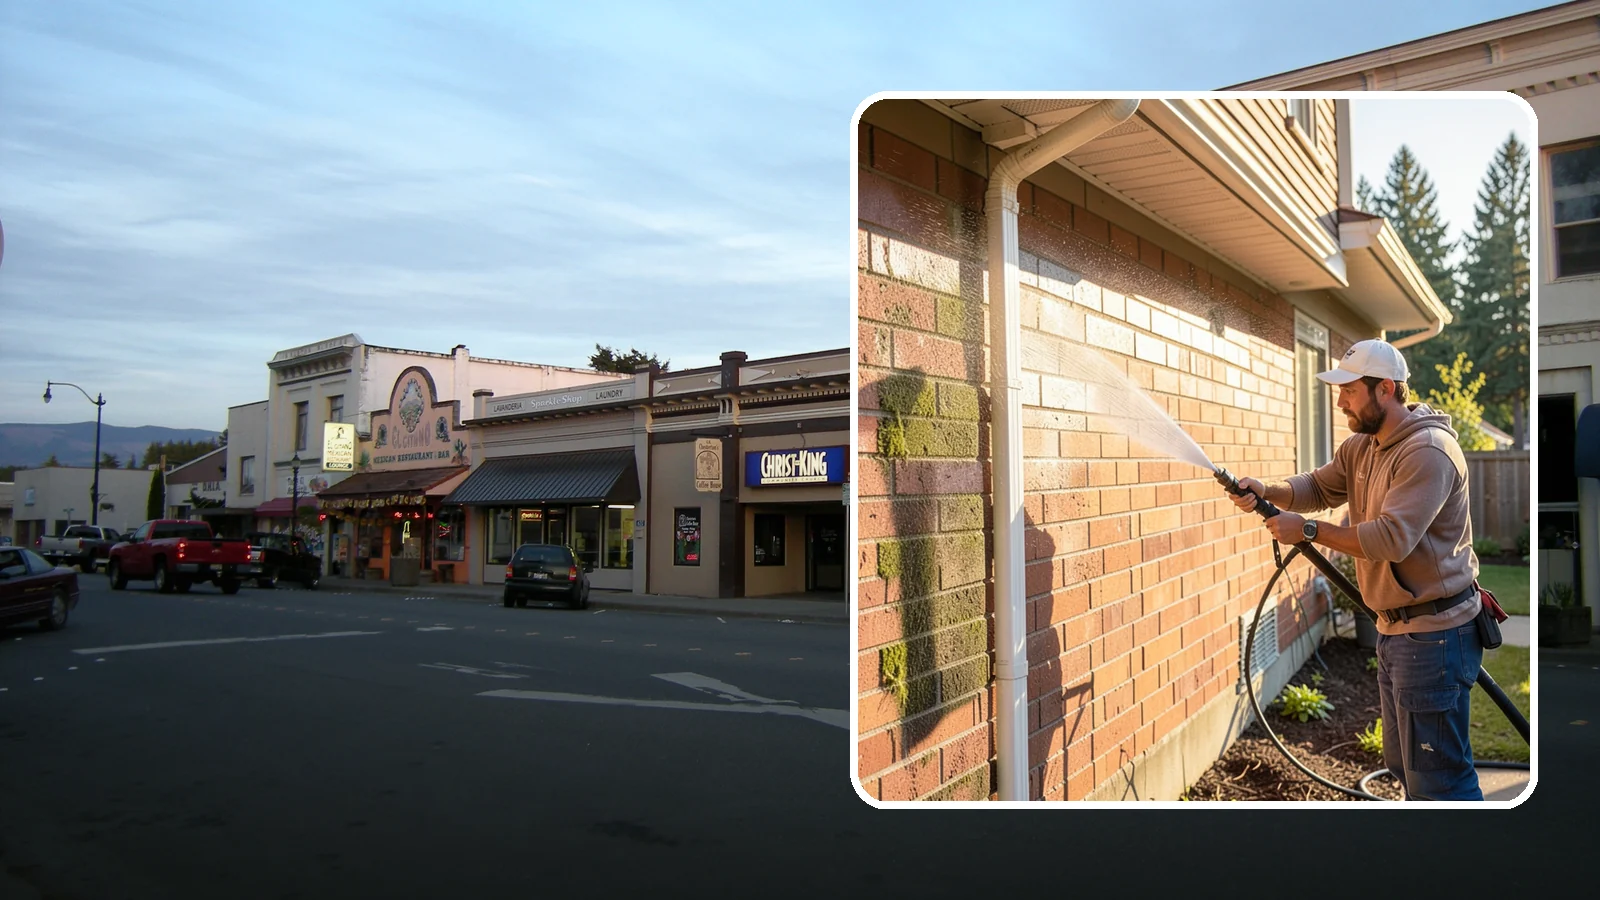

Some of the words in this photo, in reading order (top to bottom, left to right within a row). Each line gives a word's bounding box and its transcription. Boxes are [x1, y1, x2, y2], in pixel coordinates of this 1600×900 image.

[493, 402, 522, 412] LAVANDERIA
[531, 397, 560, 409] Sparkle
[561, 394, 582, 406] Shop
[595, 389, 623, 400] LAUNDRY
[373, 454, 396, 464] MEXICAN
[397, 451, 433, 462] RESTAURANT
[437, 450, 450, 459] BAR
[760, 452, 797, 478] CHRIST
[799, 450, 828, 477] KING
[710, 481, 722, 489] House
